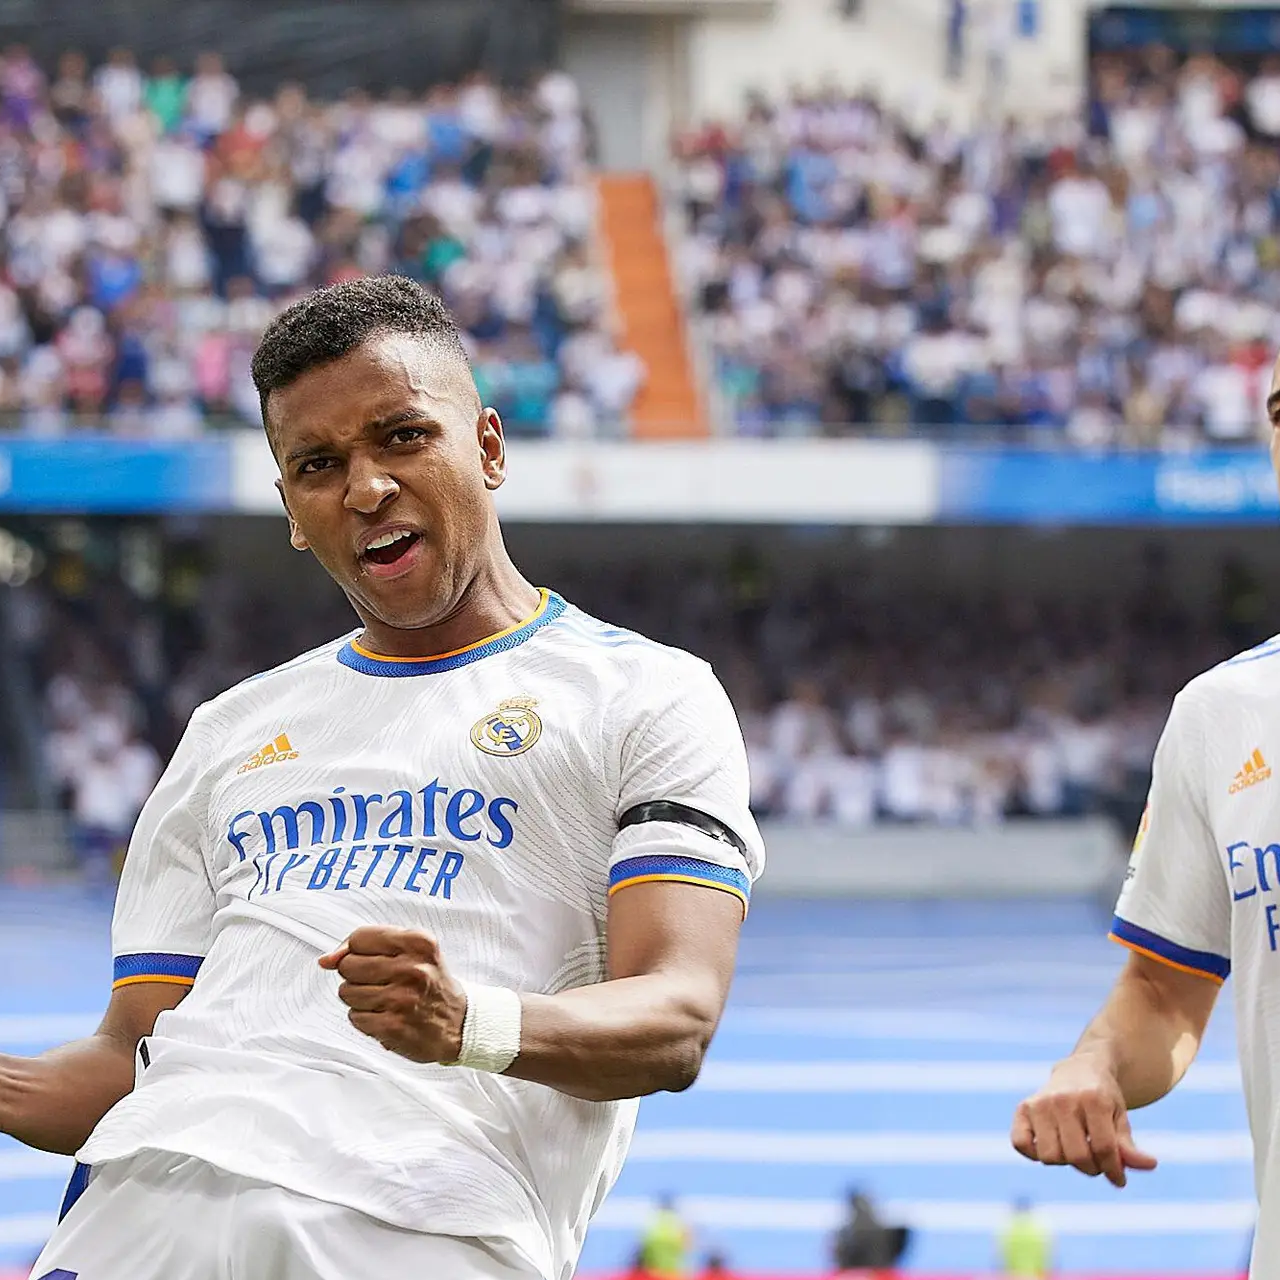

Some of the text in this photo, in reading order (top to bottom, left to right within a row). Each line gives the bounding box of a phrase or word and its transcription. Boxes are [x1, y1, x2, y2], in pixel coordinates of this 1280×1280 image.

[236, 751, 299, 775] adidas
[227, 777, 519, 862] Emirates
[306, 844, 465, 901] BETTER
